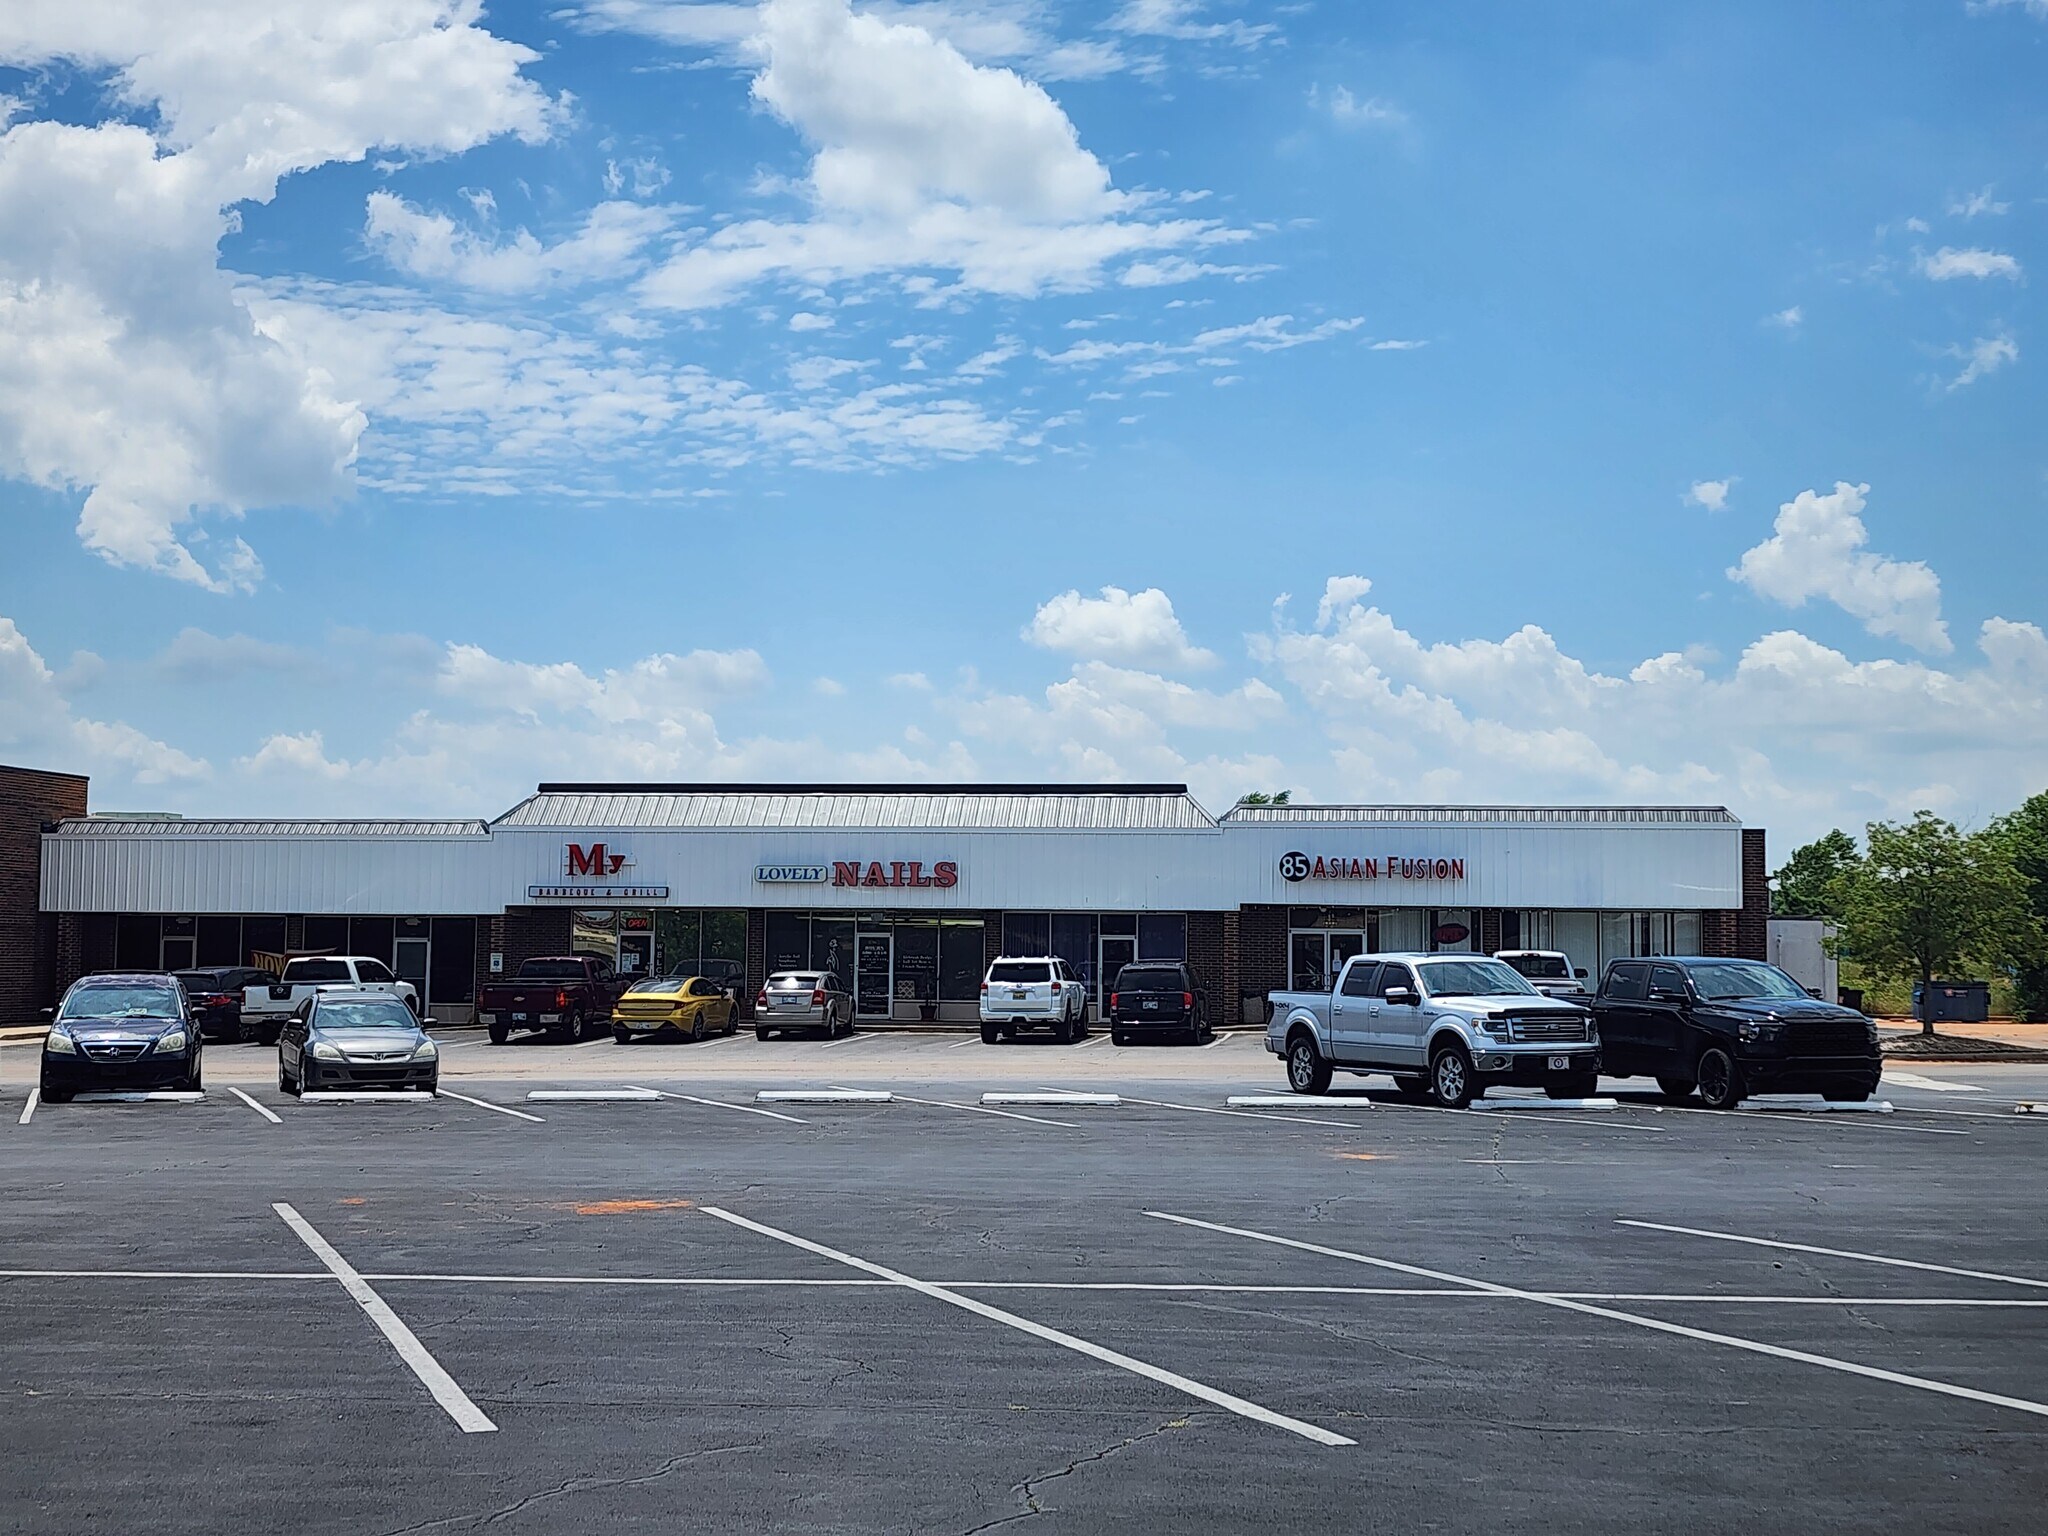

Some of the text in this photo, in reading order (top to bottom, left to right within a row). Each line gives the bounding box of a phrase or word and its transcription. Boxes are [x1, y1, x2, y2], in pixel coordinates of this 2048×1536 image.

[564, 843, 626, 876] My
[1281, 855, 1465, 880] 85 ASIAN FUSION
[757, 867, 824, 880] LOVELY
[832, 861, 958, 888] NAILS
[538, 888, 658, 896] BARBEQUE & GRILL
[627, 918, 647, 928] OPEN
[253, 953, 286, 976] NOW
